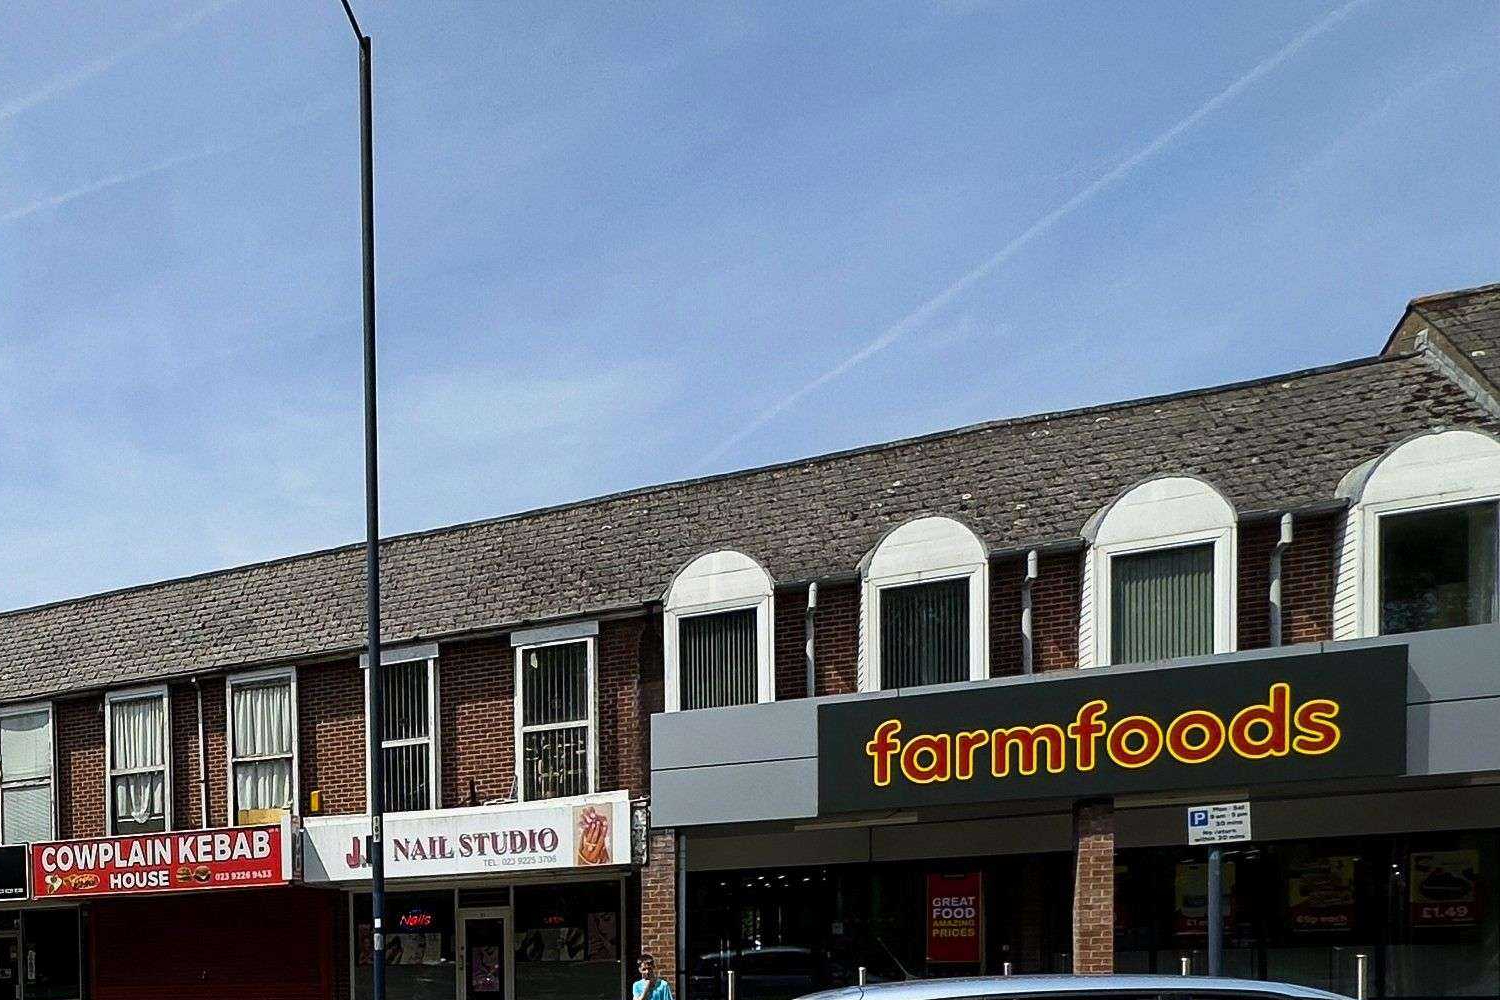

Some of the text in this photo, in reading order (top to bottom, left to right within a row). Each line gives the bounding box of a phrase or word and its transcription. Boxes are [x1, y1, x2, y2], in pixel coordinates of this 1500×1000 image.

[866, 682, 1341, 786] farmfoods
[393, 835, 455, 862] NAIL
[458, 827, 559, 858] STUDIO
[41, 830, 271, 873] COWPLAIN KEBAB
[109, 870, 171, 890] HOUSE
[214, 872, 229, 881] 023
[932, 896, 976, 907] GREAT
[932, 907, 976, 919] FOOD
[1421, 905, 1469, 919] £1.49
[400, 913, 432, 926] Nails
[932, 919, 975, 927] AMAZING
[932, 928, 975, 937] PRICES
